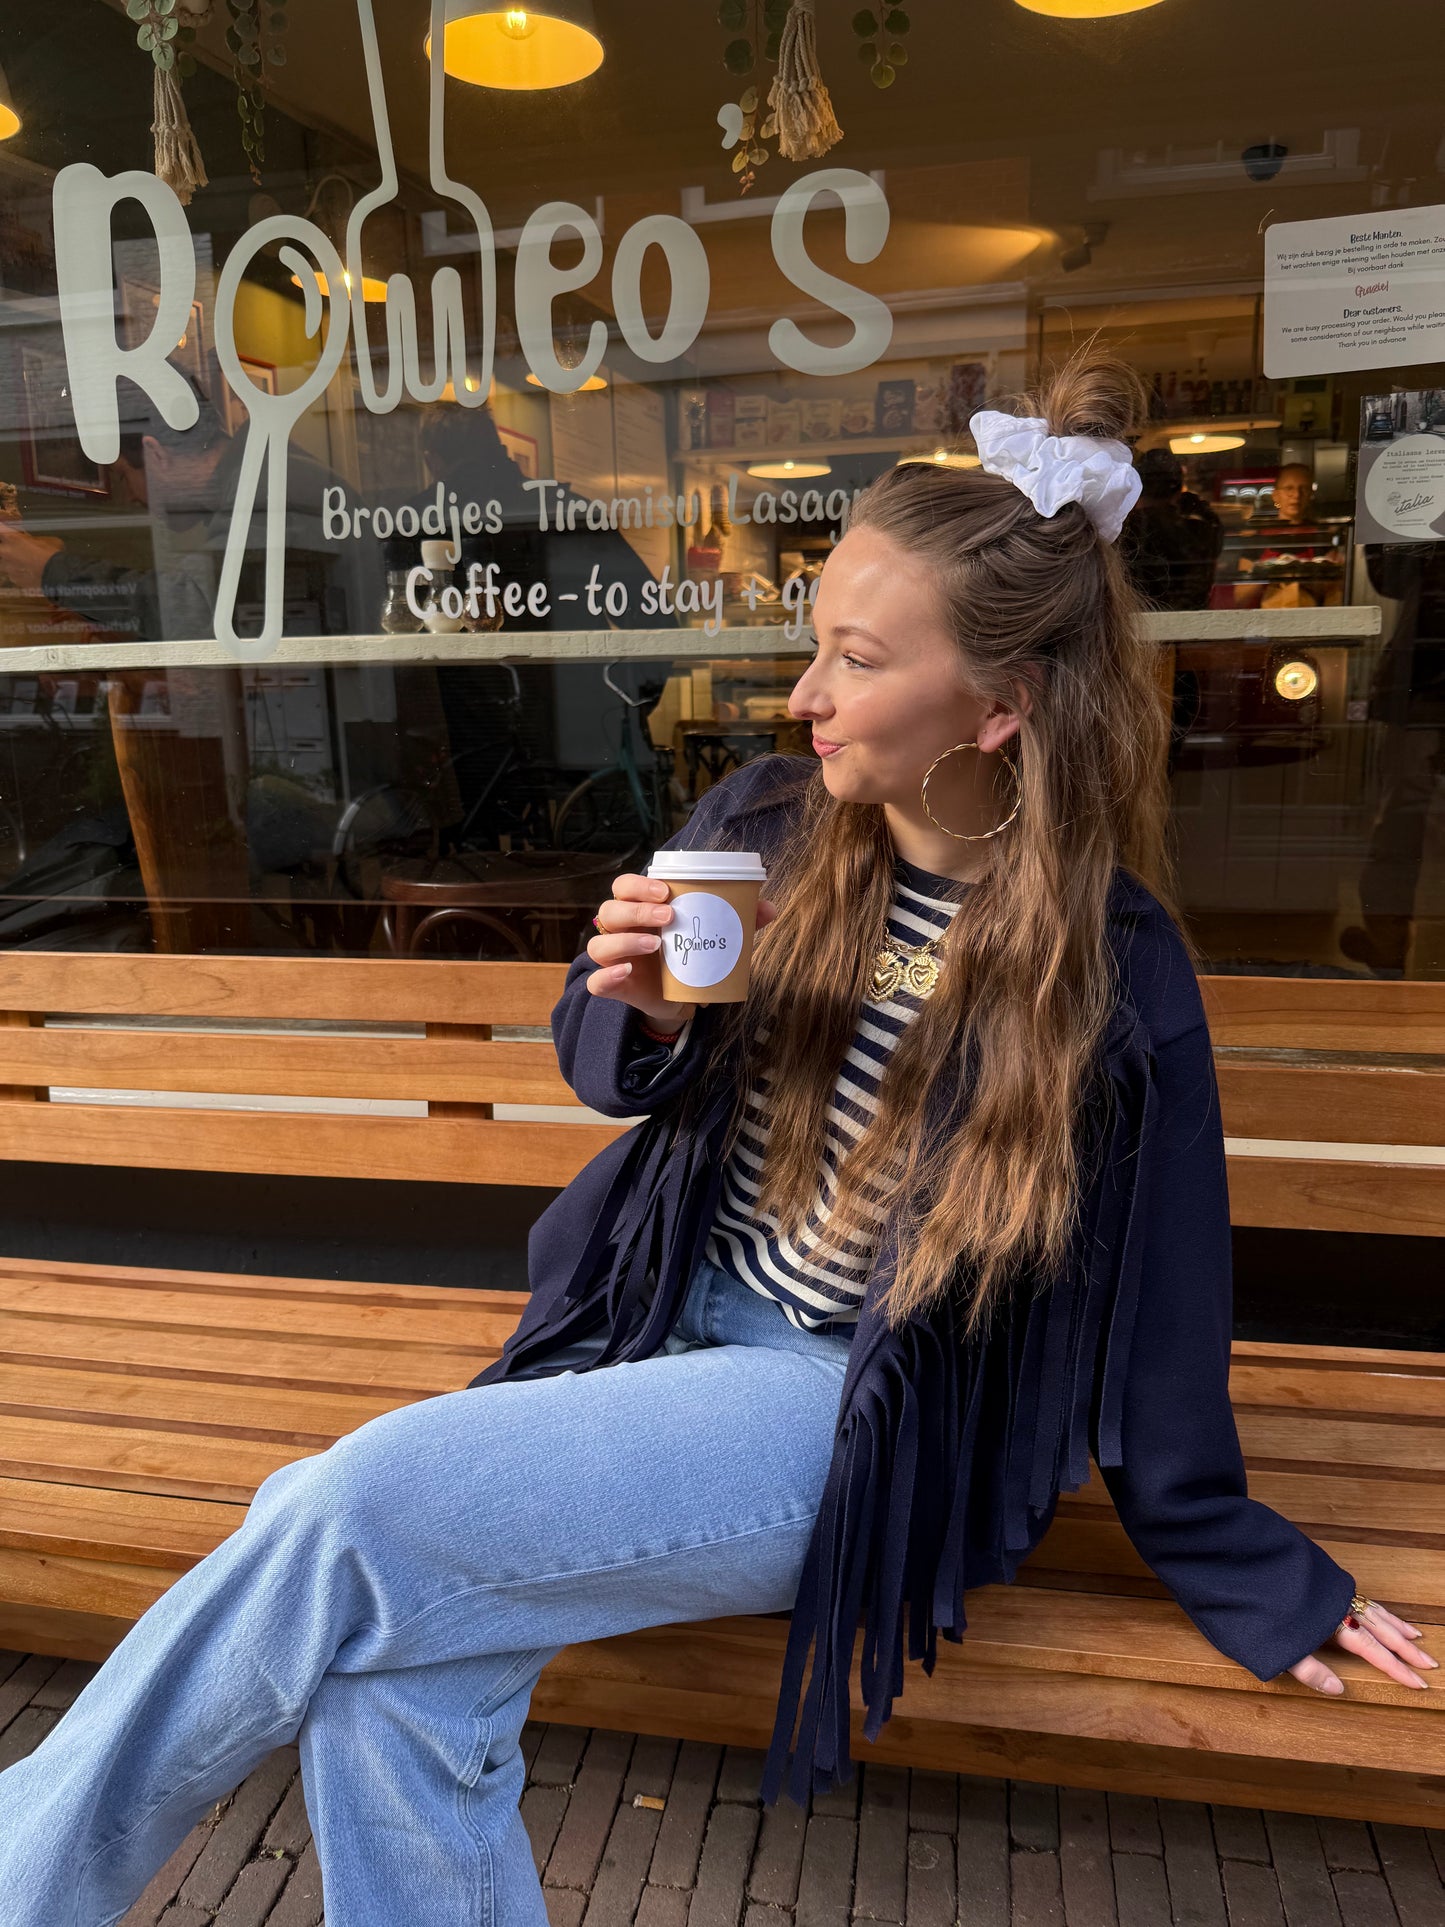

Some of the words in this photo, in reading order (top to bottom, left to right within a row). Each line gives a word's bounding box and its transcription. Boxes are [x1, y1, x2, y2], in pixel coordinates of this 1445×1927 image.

[1288, 252, 1299, 260] zijn
[1301, 250, 1314, 258] druk
[1335, 248, 1341, 256] je
[1343, 244, 1374, 253] bestelling
[1408, 238, 1432, 246] maken.
[1351, 233, 1371, 244] Beste
[1293, 261, 1320, 269] wachten
[1342, 256, 1369, 264] rekening
[1391, 250, 1415, 258] houden
[1417, 248, 1430, 256] met
[1348, 266, 1356, 274] Bij
[1357, 264, 1386, 272] voorbaat
[1388, 261, 1404, 269] dank
[1306, 324, 1320, 332] busy
[1322, 321, 1356, 330] processing
[1393, 314, 1414, 322] Would
[1344, 308, 1361, 318] Dear
[53, 0, 893, 660] Romeo's
[1309, 332, 1352, 341] consideration
[1374, 326, 1406, 336] neighbors
[1407, 322, 1424, 330] while
[1338, 340, 1356, 348] Thank
[1378, 336, 1406, 344] advance
[1394, 493, 1434, 514] italia
[323, 480, 503, 565] Broodjes
[522, 479, 699, 533] Tiramisu
[405, 562, 552, 622] Coffee
[641, 565, 724, 638] stay
[674, 916, 727, 966] Romeo's
